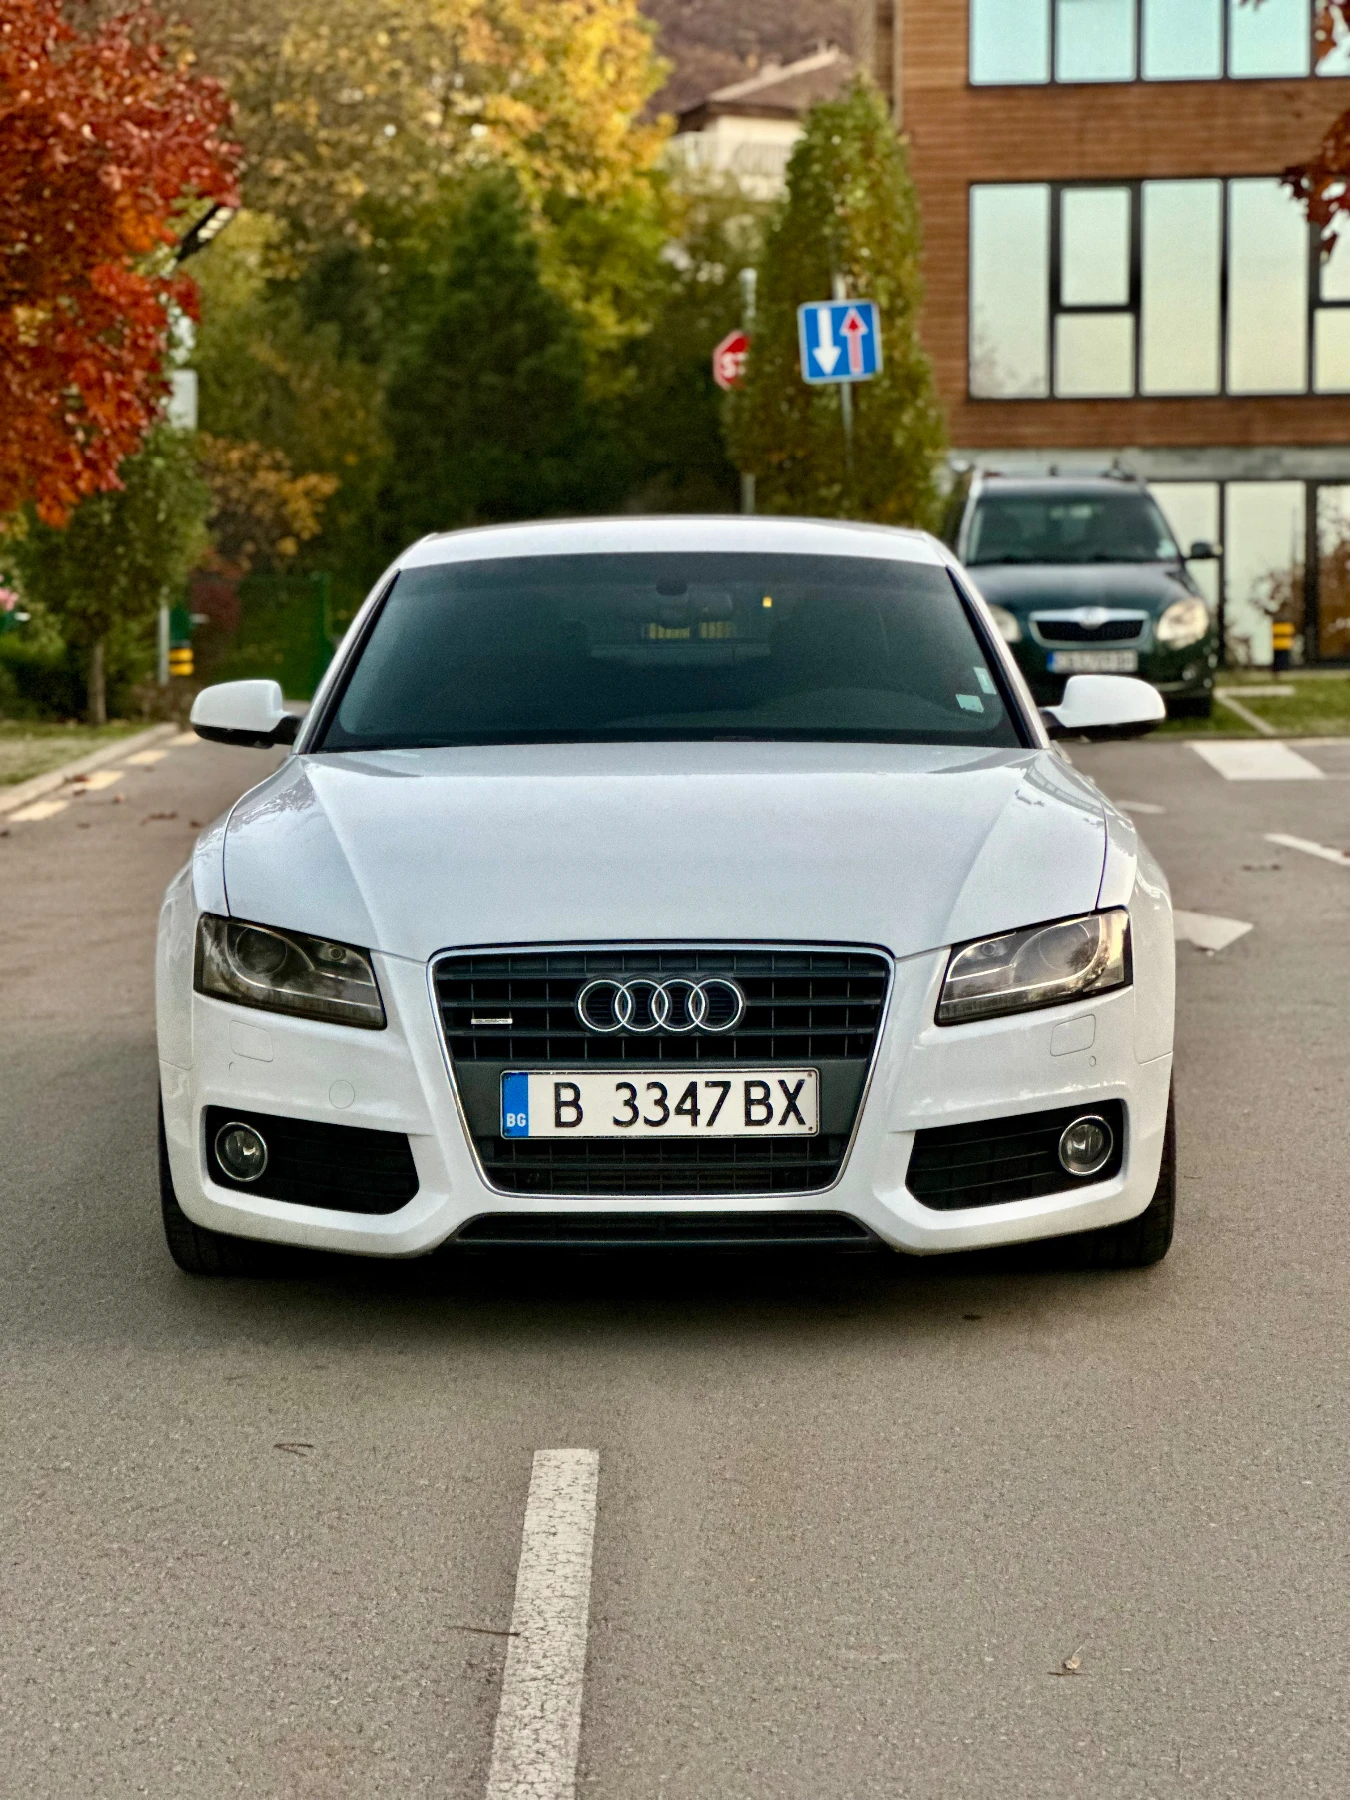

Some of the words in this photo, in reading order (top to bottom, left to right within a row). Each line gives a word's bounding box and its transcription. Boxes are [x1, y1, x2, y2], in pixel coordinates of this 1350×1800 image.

[554, 1082, 584, 1127] B
[612, 1080, 731, 1127] 3347
[744, 1079, 806, 1127] BX
[506, 1113, 526, 1127] BG
